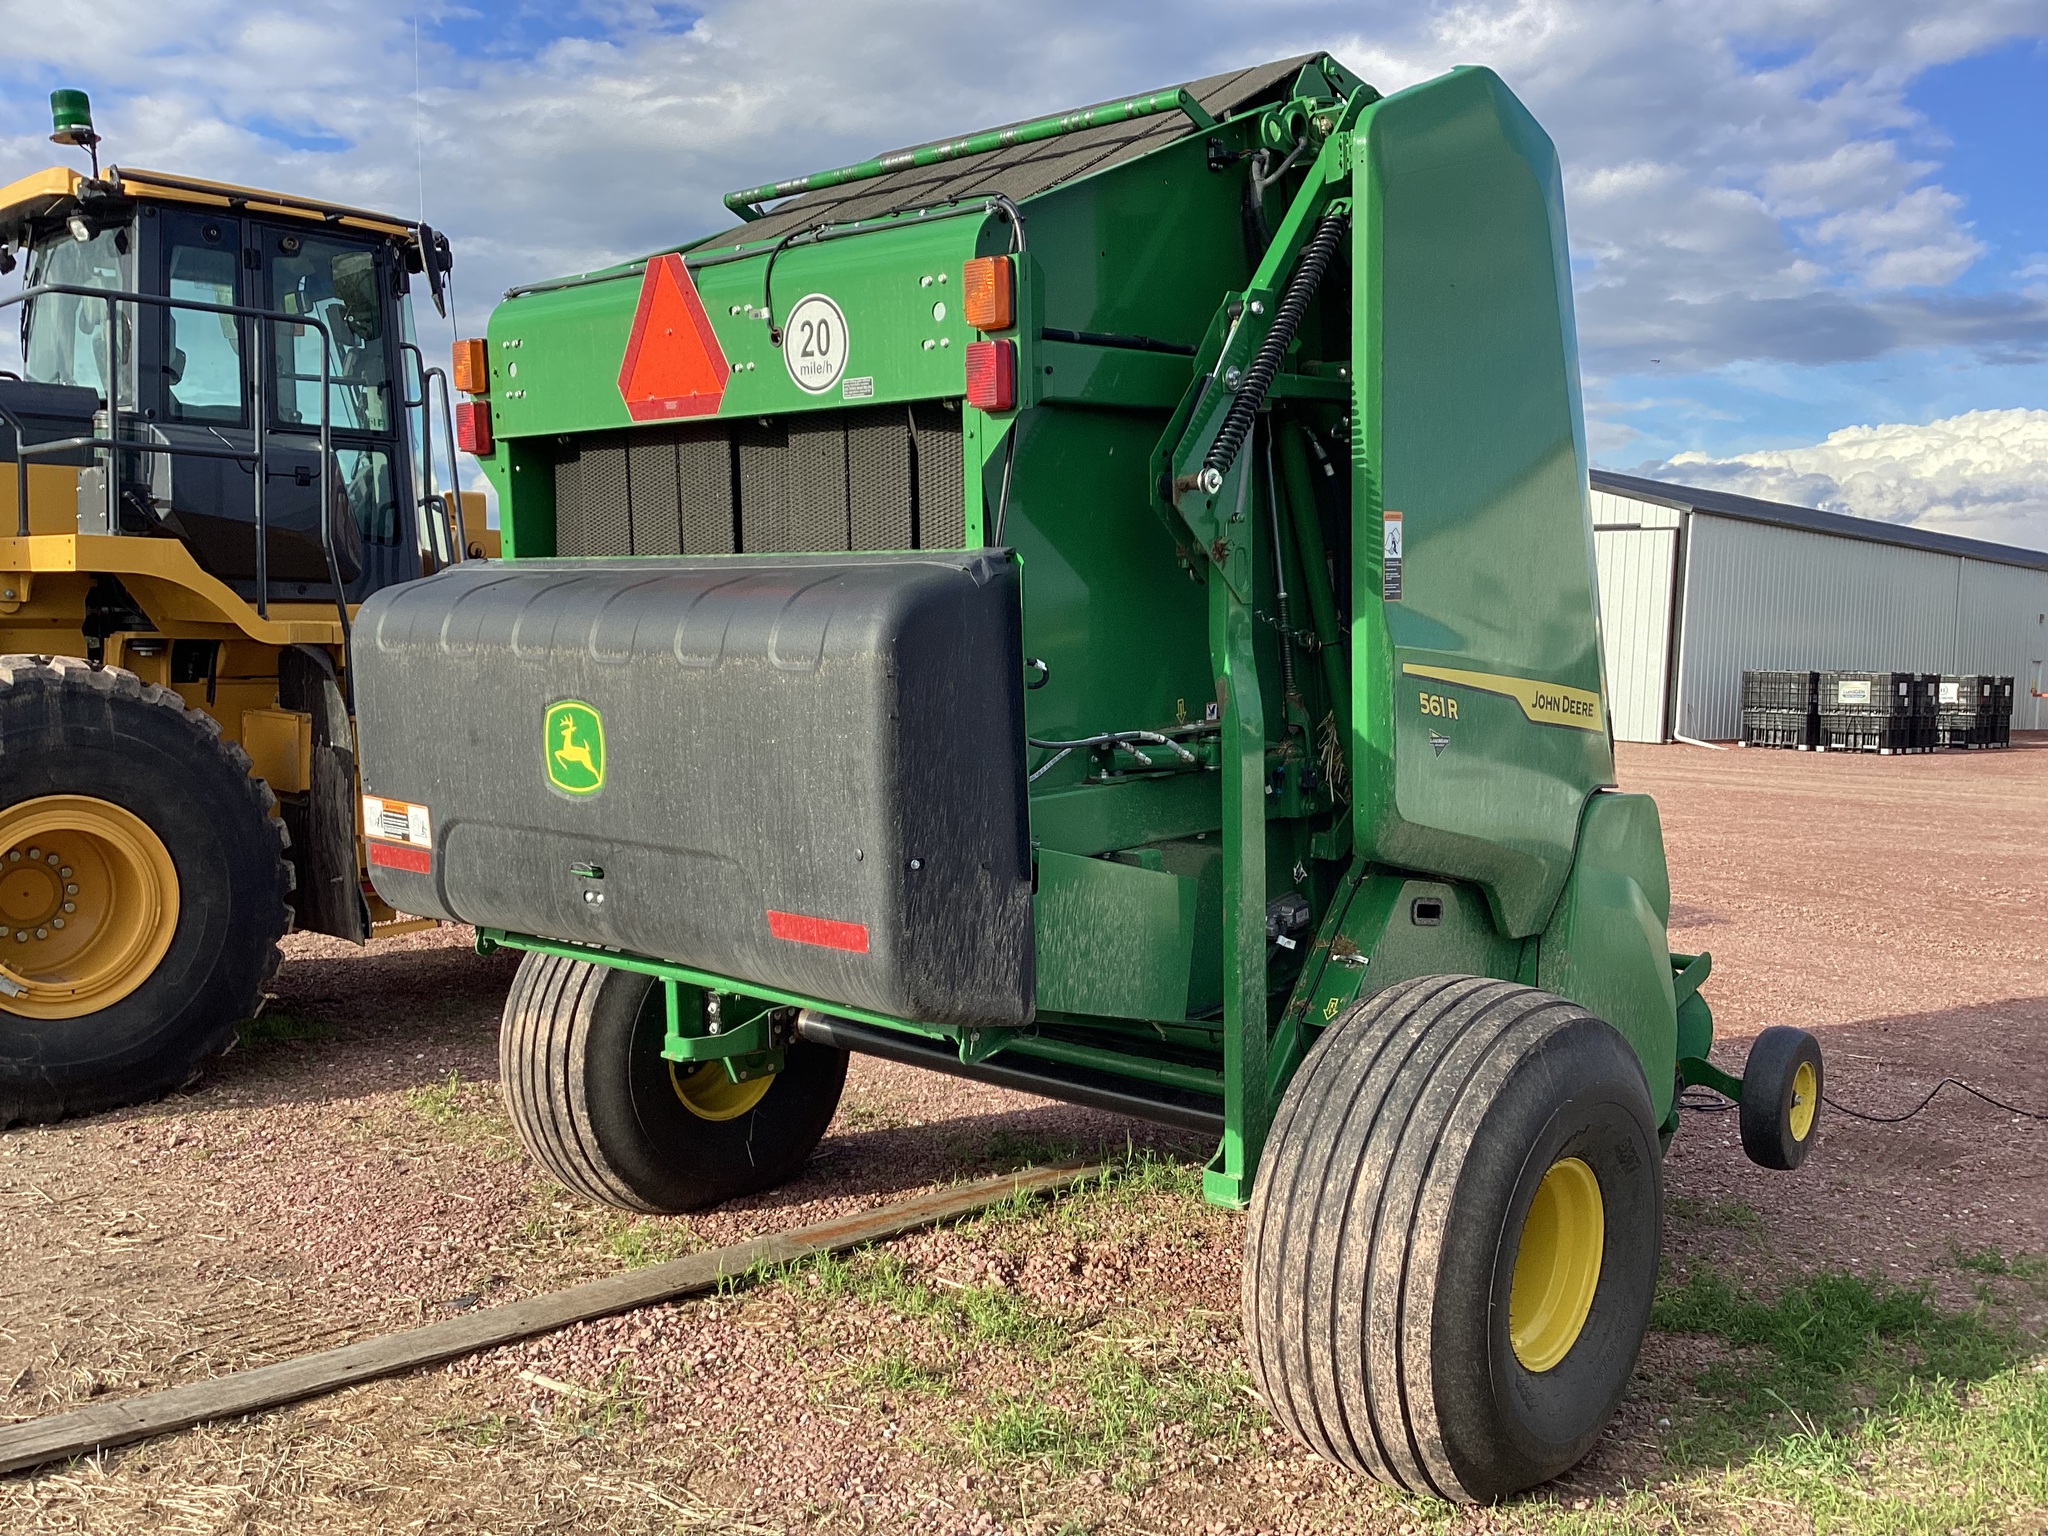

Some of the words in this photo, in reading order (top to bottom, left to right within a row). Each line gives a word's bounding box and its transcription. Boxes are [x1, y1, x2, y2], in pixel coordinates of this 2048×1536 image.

[800, 318, 831, 358] 20
[800, 360, 833, 376] mile/h
[1531, 690, 1560, 713] JOHN
[1562, 695, 1595, 718] DEERE
